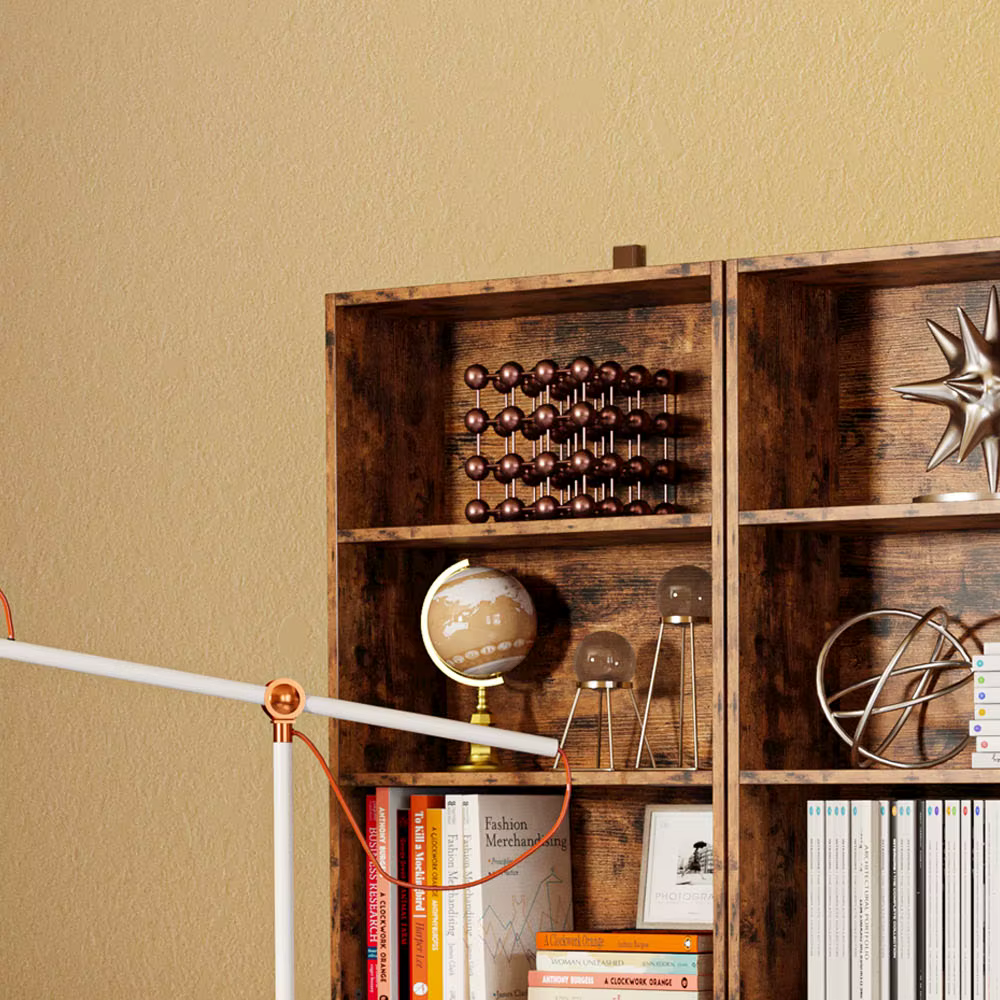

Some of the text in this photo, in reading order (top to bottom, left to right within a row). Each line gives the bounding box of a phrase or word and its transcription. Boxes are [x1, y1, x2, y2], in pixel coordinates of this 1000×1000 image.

[414, 811, 424, 824] To
[485, 817, 528, 830] Fashion
[415, 824, 424, 842] Kill
[448, 835, 458, 872] Fashion
[369, 884, 377, 943] RESEARCH
[416, 922, 424, 968] Harper Lee
[542, 976, 568, 984] ANTHONY
[570, 976, 594, 984] BURGESS
